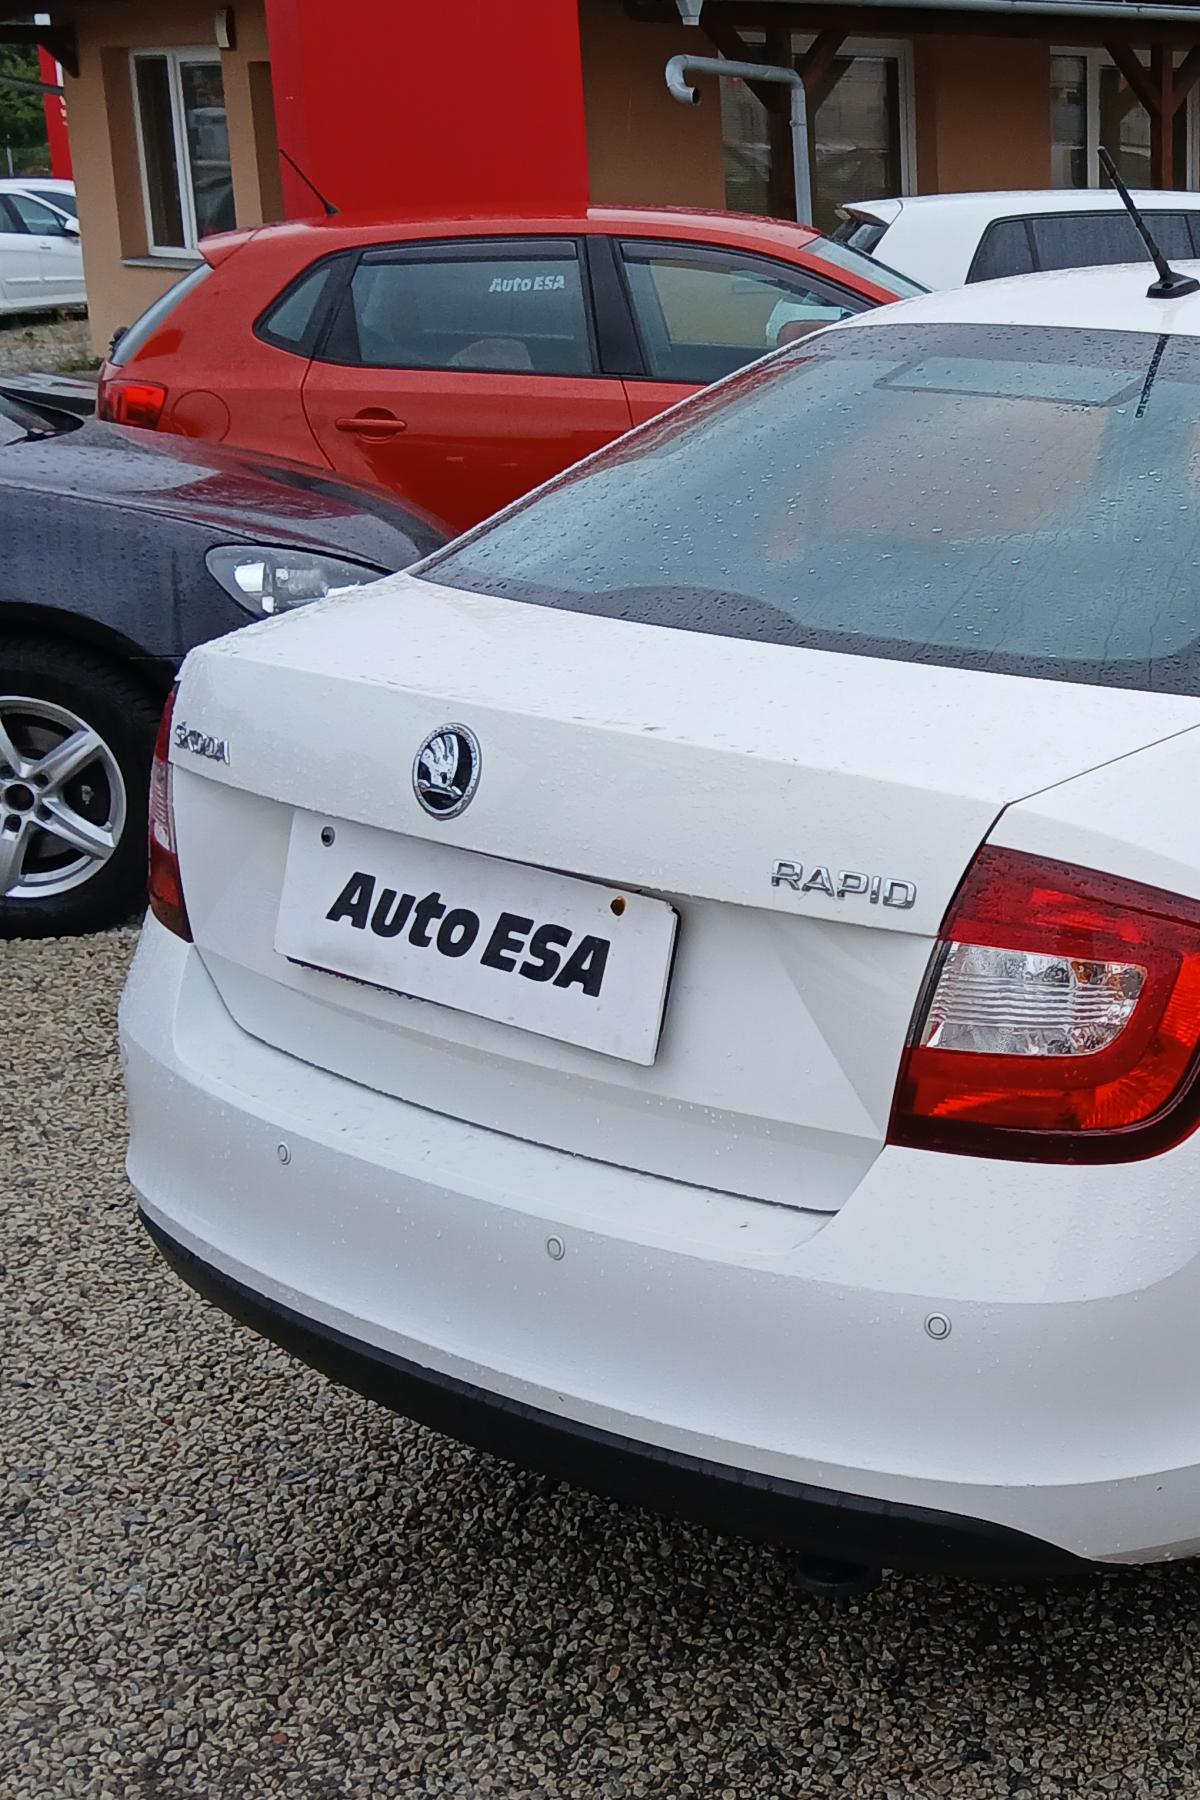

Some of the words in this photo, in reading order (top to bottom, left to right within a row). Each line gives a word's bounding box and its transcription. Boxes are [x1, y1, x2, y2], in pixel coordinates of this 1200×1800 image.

[488, 277, 532, 293] Auto
[533, 275, 565, 291] ESA
[771, 858, 917, 910] RAPID
[325, 871, 480, 958] Auto
[480, 911, 611, 998] ESA
